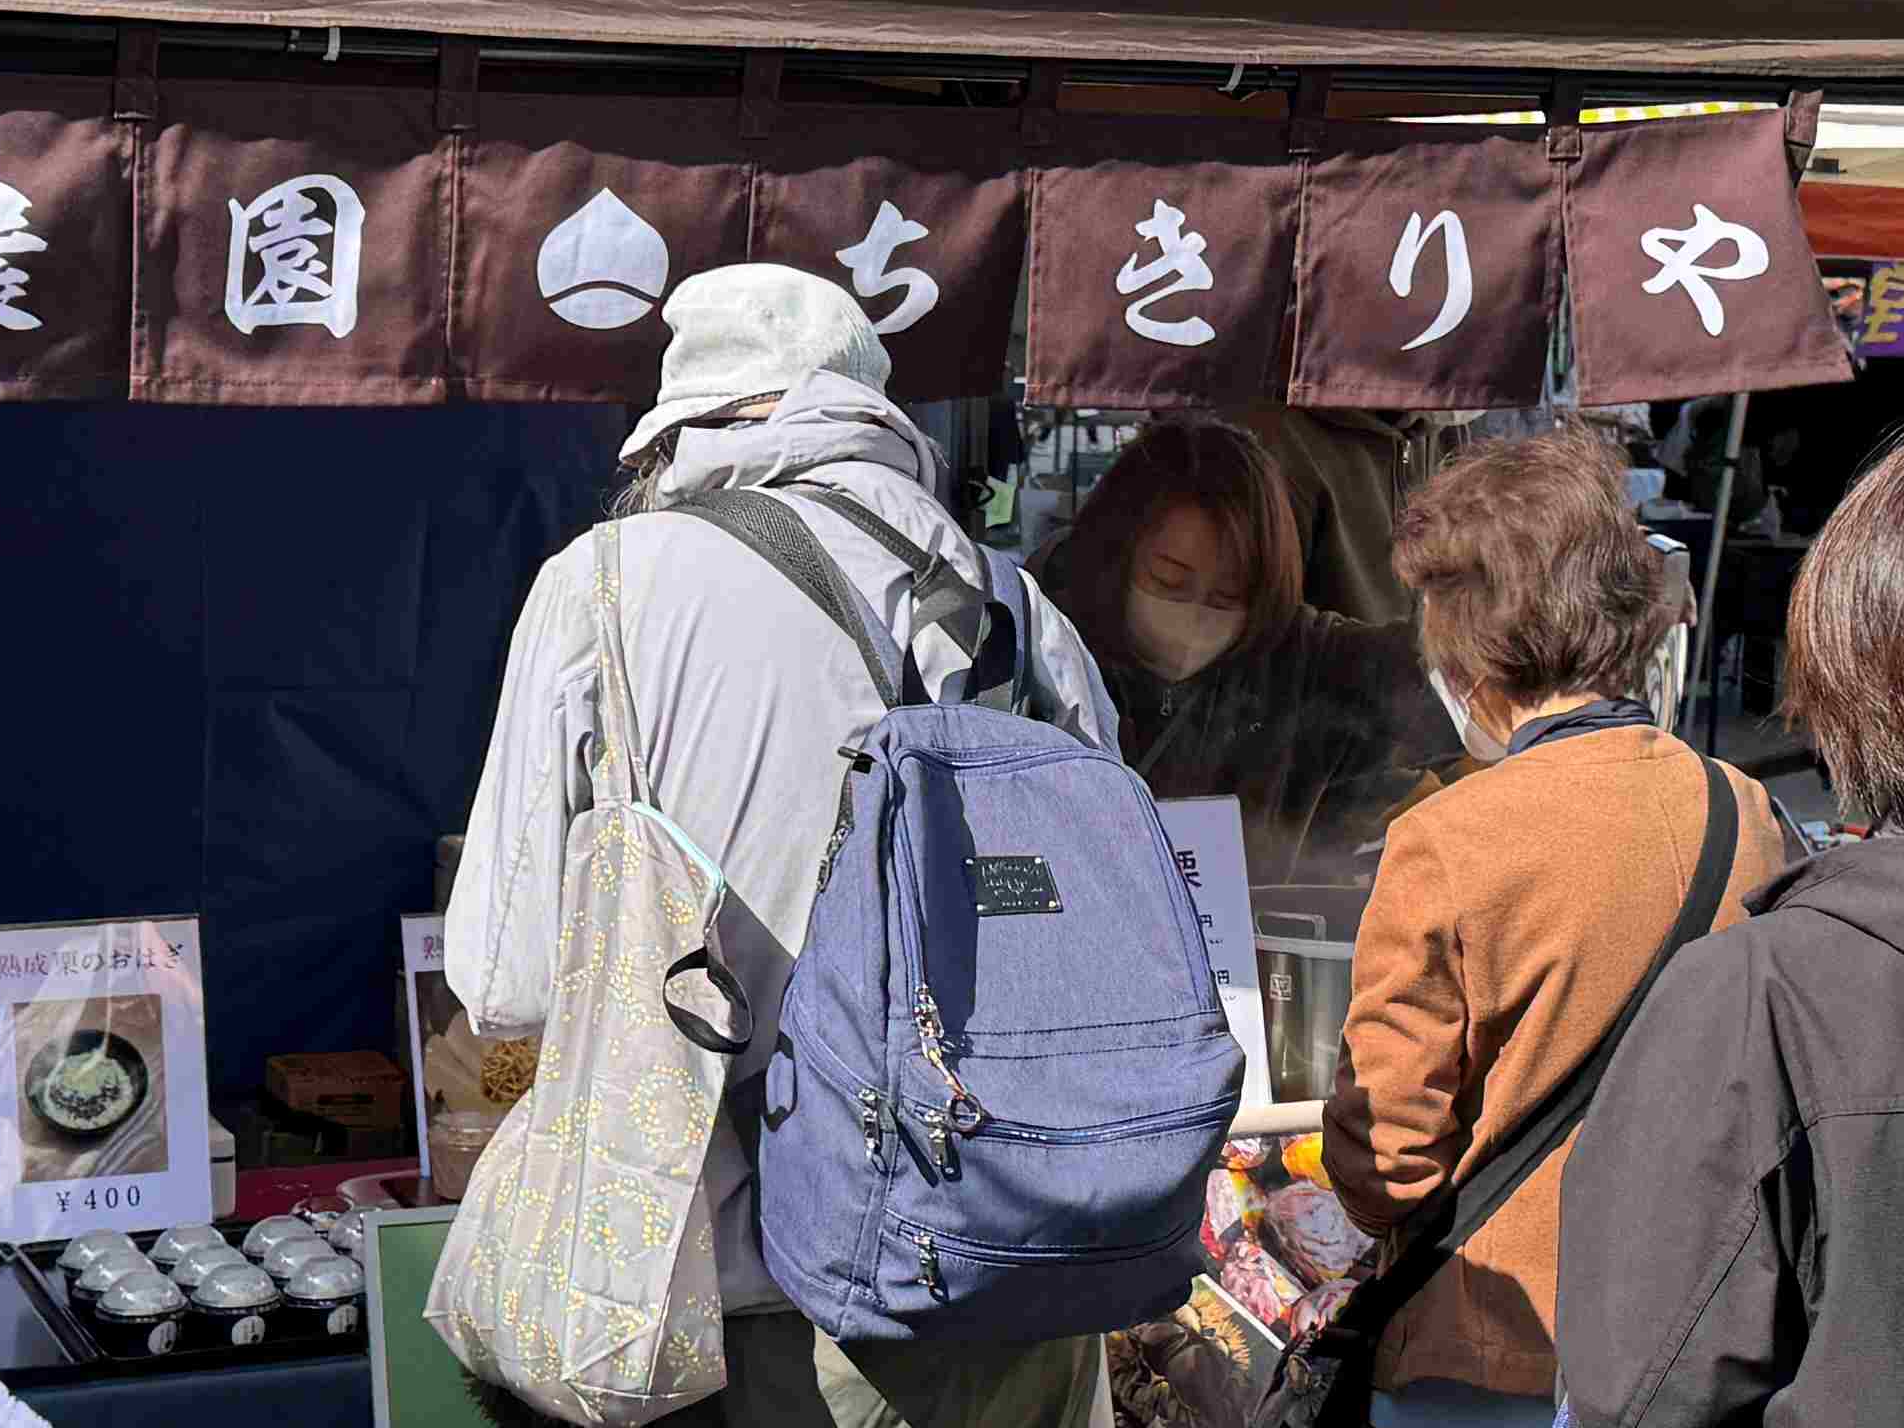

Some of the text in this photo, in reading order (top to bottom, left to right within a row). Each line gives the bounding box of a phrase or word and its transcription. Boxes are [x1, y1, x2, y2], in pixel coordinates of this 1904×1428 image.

[834, 198, 1770, 352] ちきりや
[55, 1184, 143, 1214] ¥400
